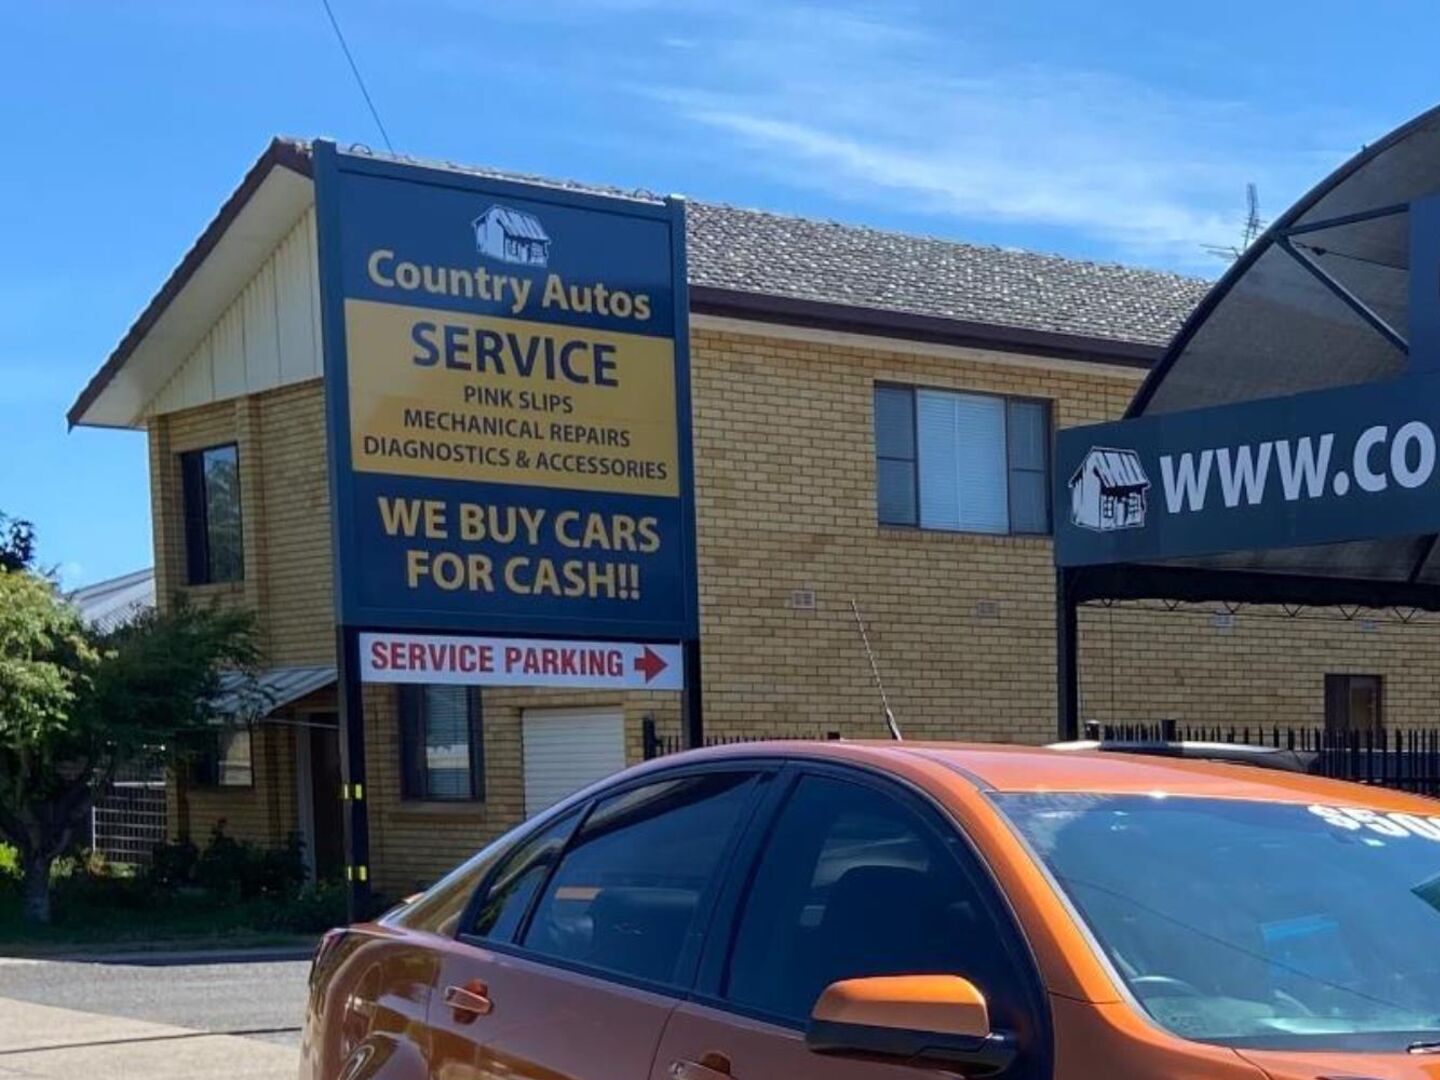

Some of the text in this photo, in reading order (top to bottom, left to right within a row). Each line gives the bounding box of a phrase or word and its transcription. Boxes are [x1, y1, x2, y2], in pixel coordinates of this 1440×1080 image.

[368, 249, 651, 320] Country Autos
[411, 321, 619, 387] SERVICE
[463, 386, 573, 414] PINK SLIPS
[403, 409, 630, 447] MECHANICAL REPAIRS
[363, 435, 667, 480] DIAGNOSTICS & ACCESSORIES
[378, 496, 661, 553] WE BUY CARS
[407, 550, 640, 600] FOR CASH!!
[371, 641, 624, 678] SERVICE PARKING
